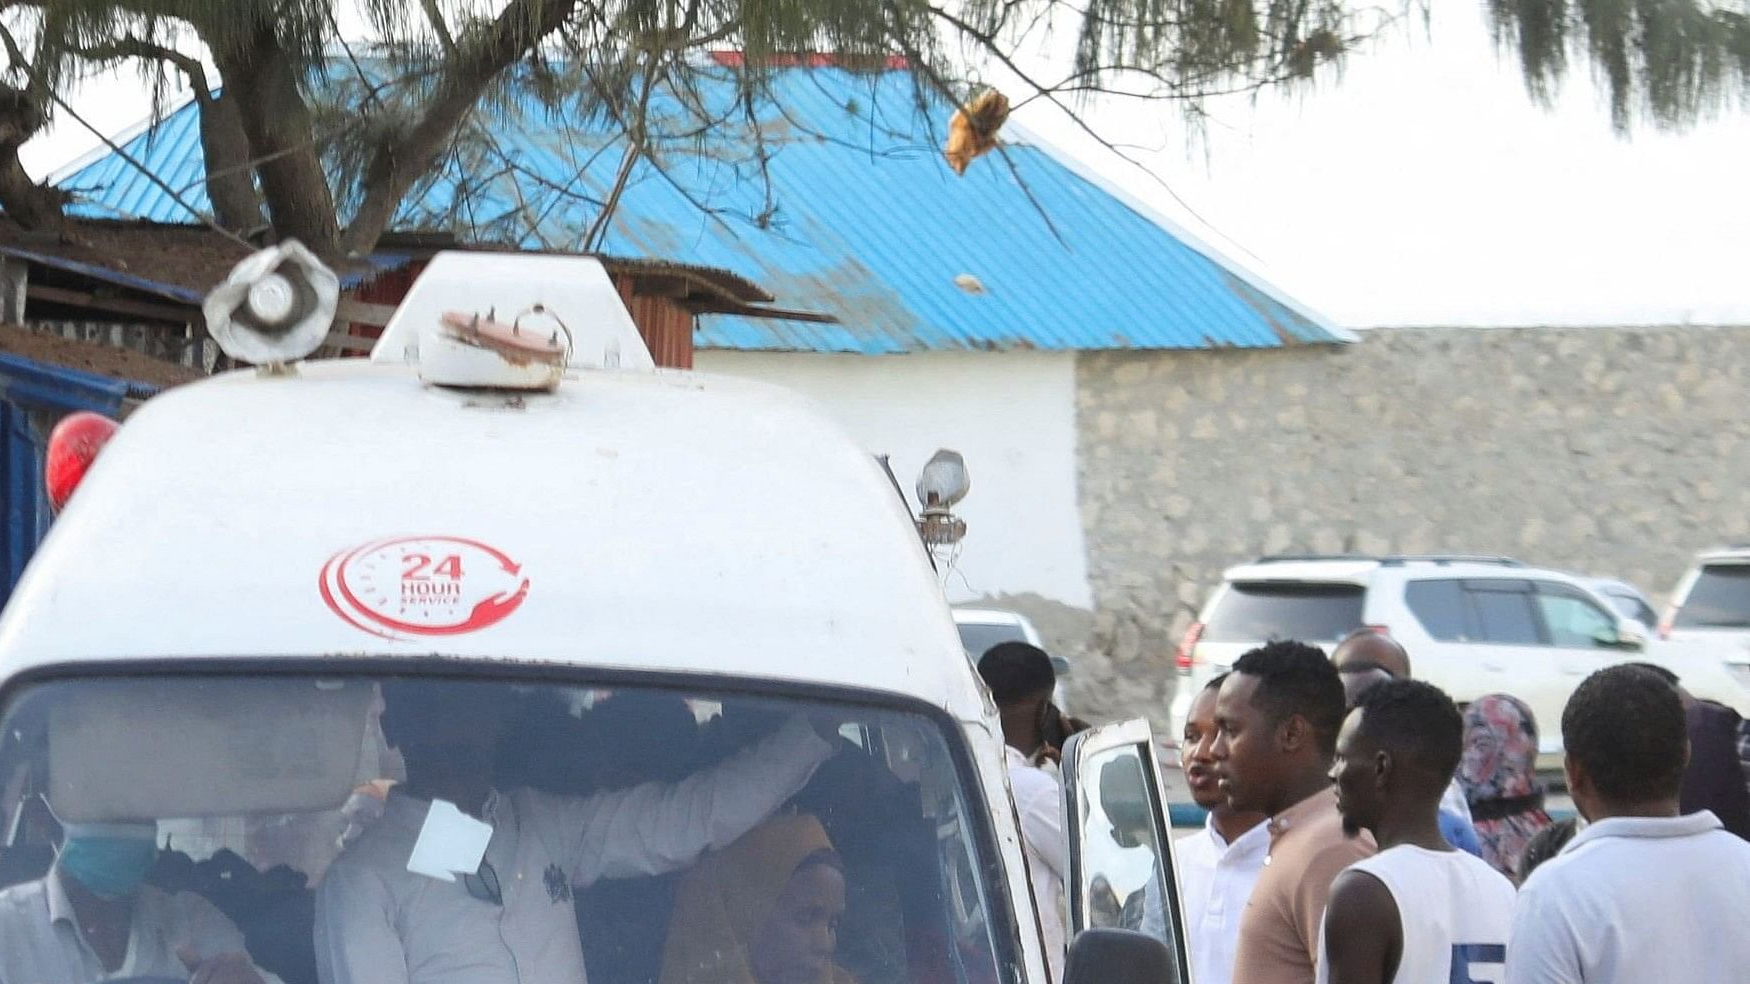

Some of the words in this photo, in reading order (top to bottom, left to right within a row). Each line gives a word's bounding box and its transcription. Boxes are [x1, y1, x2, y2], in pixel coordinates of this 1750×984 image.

[402, 553, 464, 580] 24
[401, 583, 461, 596] HOUR
[401, 597, 460, 605] SERVICE
